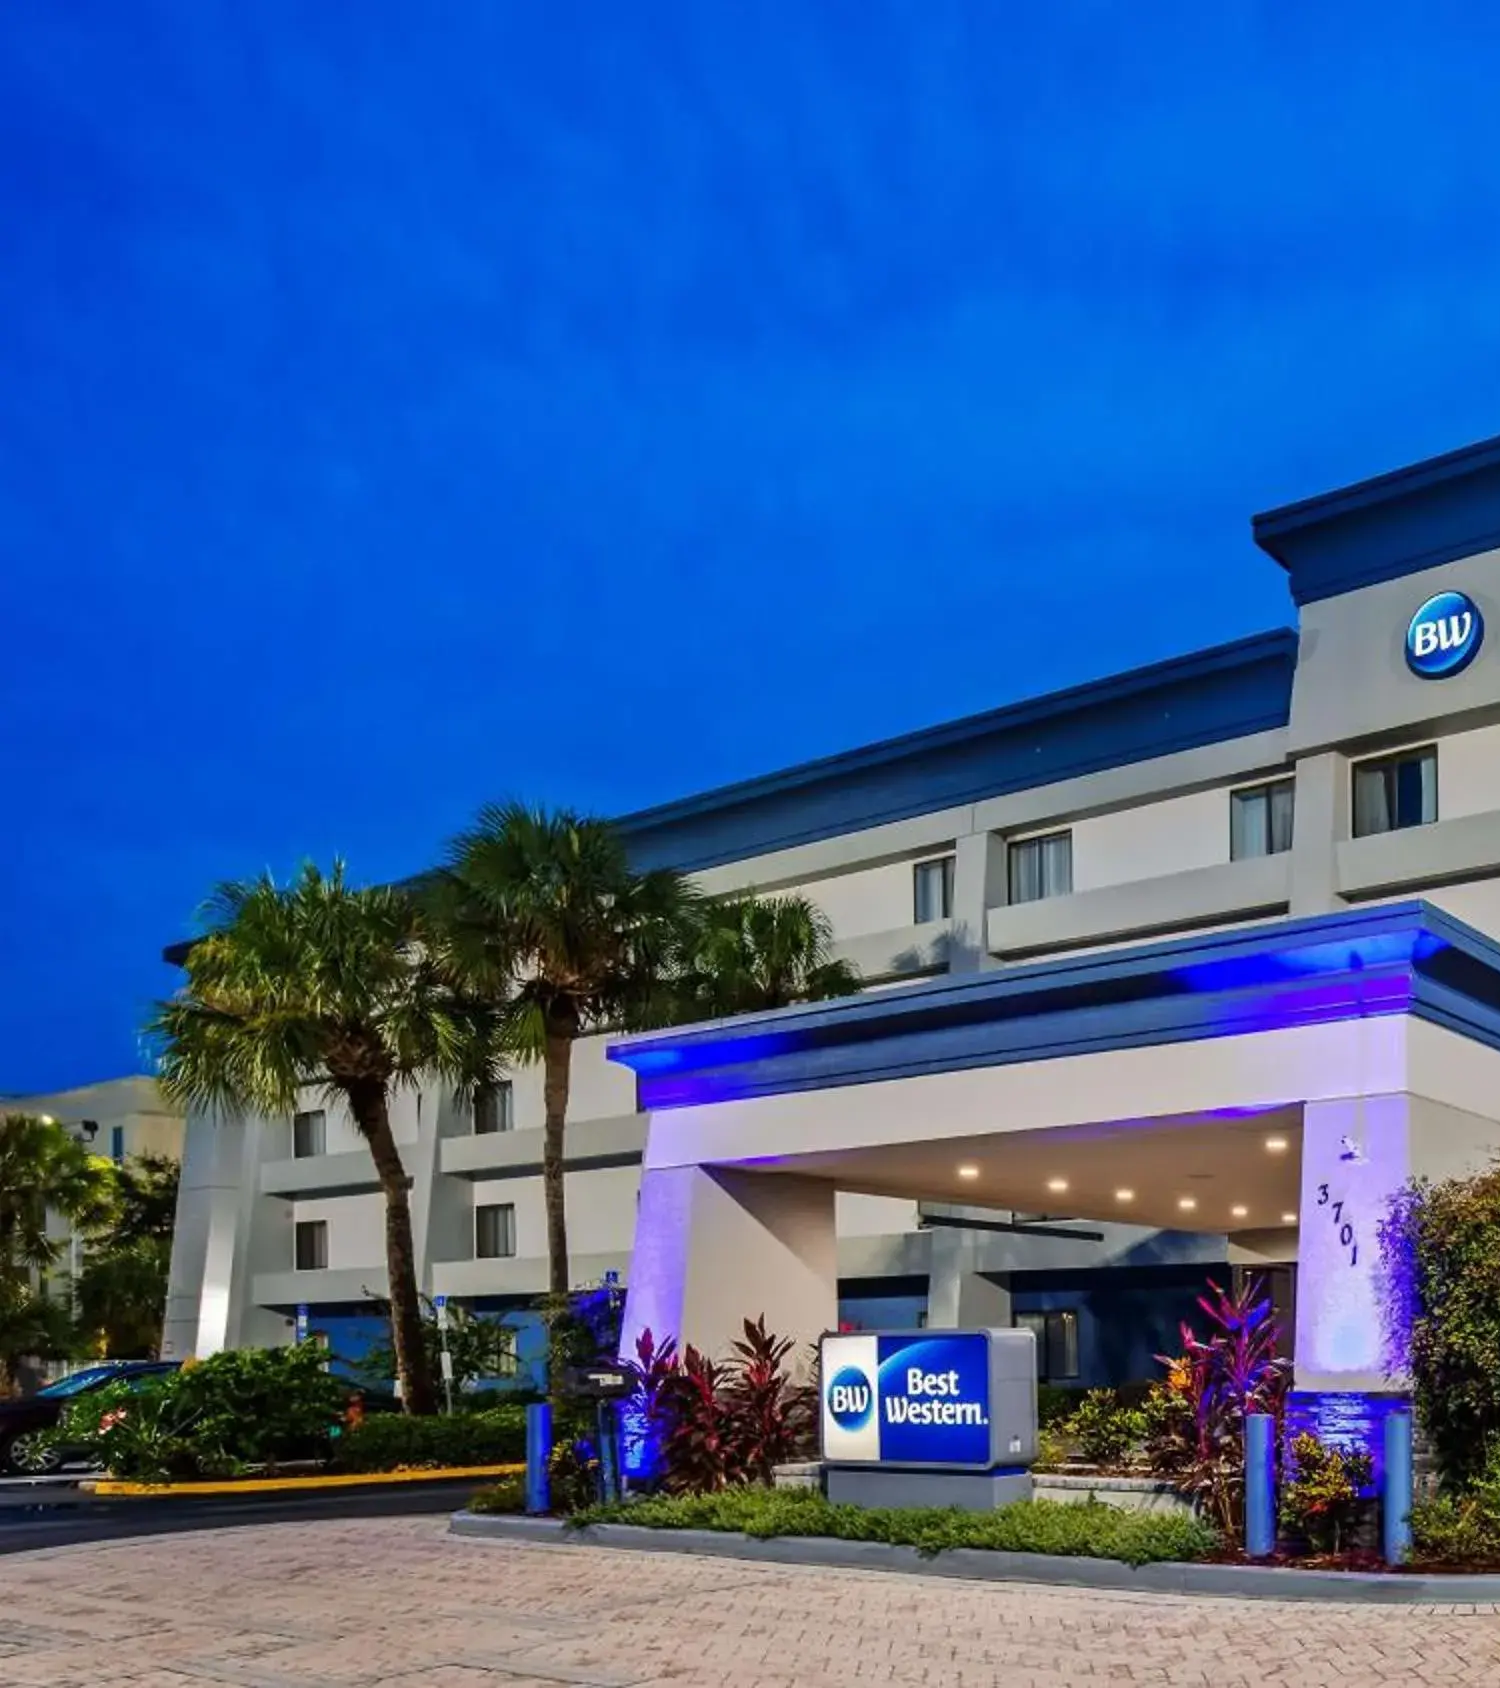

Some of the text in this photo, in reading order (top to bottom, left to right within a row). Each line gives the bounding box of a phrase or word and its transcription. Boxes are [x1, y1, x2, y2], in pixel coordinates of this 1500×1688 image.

[1413, 610, 1472, 657] BW
[906, 1367, 960, 1397] Best
[832, 1385, 869, 1414] BW
